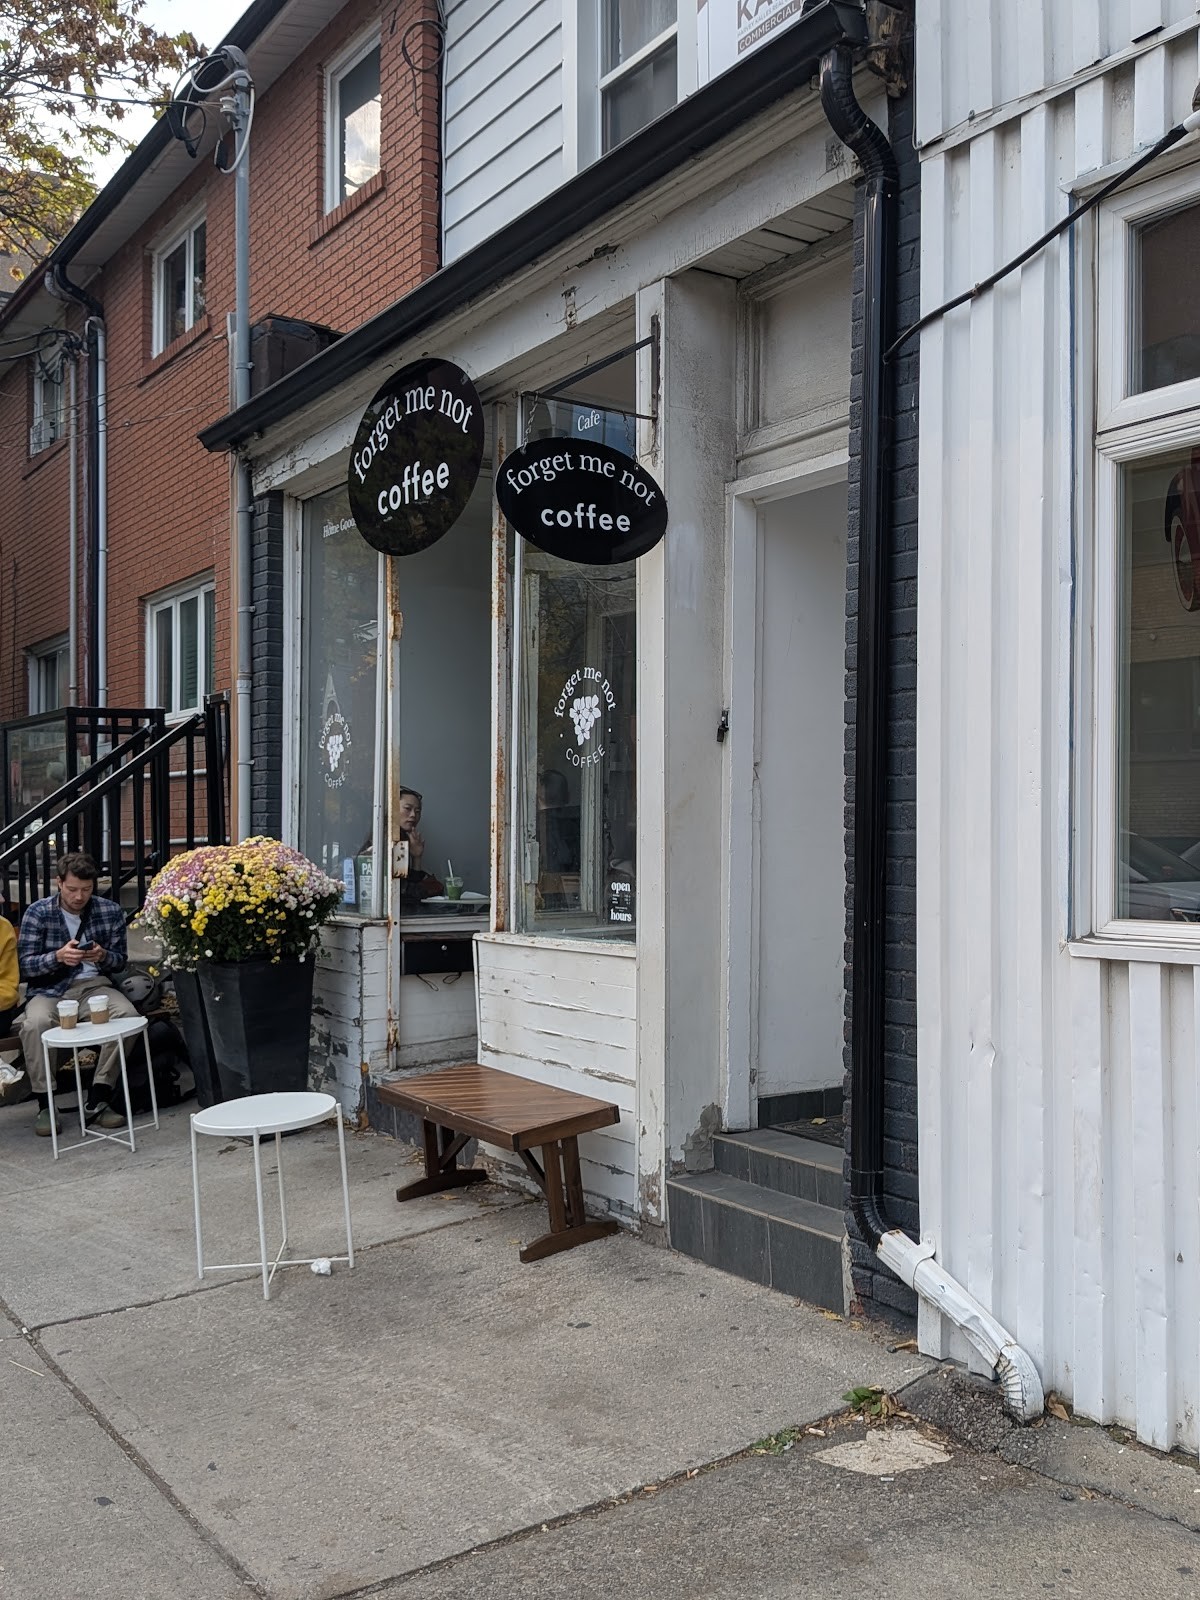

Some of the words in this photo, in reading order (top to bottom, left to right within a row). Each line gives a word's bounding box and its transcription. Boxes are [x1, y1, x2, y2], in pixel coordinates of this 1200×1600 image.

[739, 2, 798, 51] COMMERCIAL
[353, 397, 402, 484] forget
[405, 386, 435, 415] me
[439, 389, 473, 434] not
[577, 409, 601, 432] Cafe
[377, 461, 450, 515] coffee
[507, 452, 575, 494] forget
[579, 455, 615, 478] me
[620, 471, 656, 507] not
[541, 503, 631, 532] coffee
[554, 669, 582, 718] forget
[583, 667, 602, 683] me
[601, 679, 617, 711] not
[334, 713, 344, 726] me
[343, 723, 352, 748] not
[566, 744, 606, 768] COFFEE
[324, 771, 346, 789] COFFEE
[611, 882, 631, 894] open
[610, 908, 632, 922] hours
